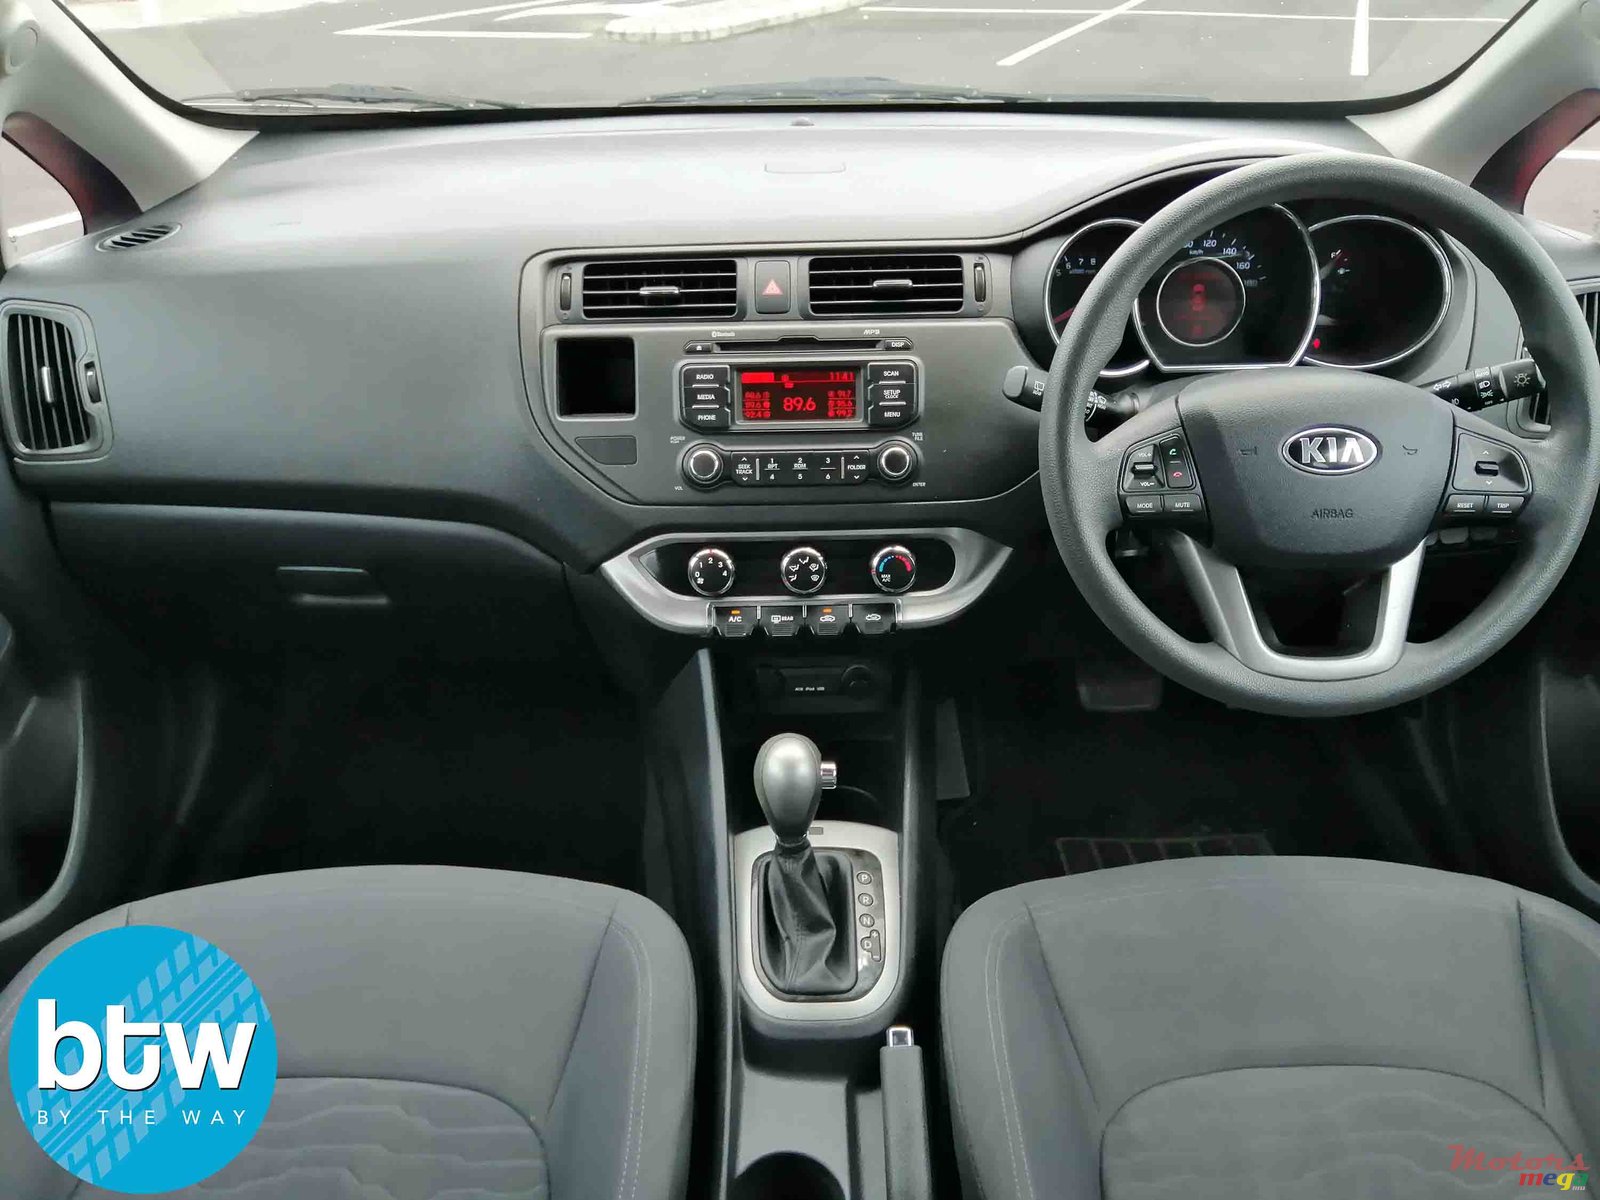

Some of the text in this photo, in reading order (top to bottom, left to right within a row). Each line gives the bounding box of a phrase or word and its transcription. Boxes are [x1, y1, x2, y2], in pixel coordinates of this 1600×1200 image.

[1065, 262, 1071, 270] 6
[1236, 262, 1251, 270] 160
[783, 397, 817, 411] 89.6
[1300, 437, 1365, 464] KIA
[1310, 508, 1354, 519] AIRBAG
[861, 874, 868, 882] P
[862, 896, 869, 904] R
[863, 916, 870, 925] N
[864, 940, 872, 949] D
